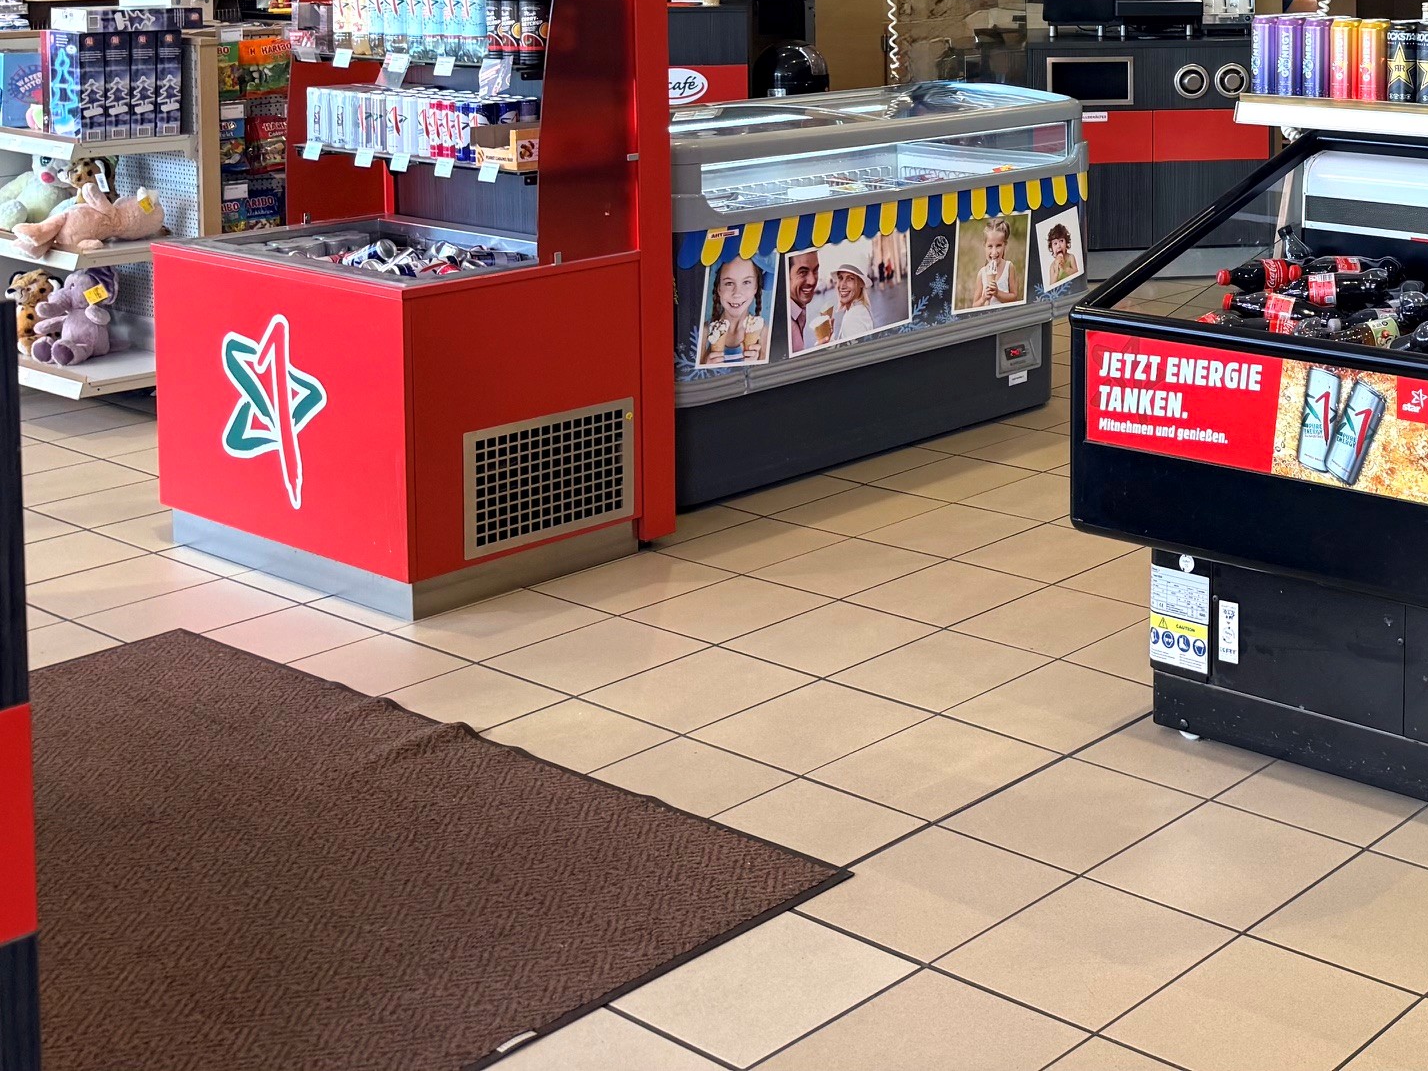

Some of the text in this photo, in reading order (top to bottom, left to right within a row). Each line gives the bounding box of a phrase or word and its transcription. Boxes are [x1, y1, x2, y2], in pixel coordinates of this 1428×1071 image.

[261, 43, 292, 55] HARIBO
[668, 74, 698, 94] café
[245, 195, 274, 208] ARIBO
[1099, 351, 1263, 392] JETZT ENERGIE
[1098, 385, 1189, 419] TANKEN.
[1402, 403, 1421, 413] star
[1098, 417, 1228, 444] Mitnehmen und genießen.
[1175, 623, 1196, 633] CAUTION
